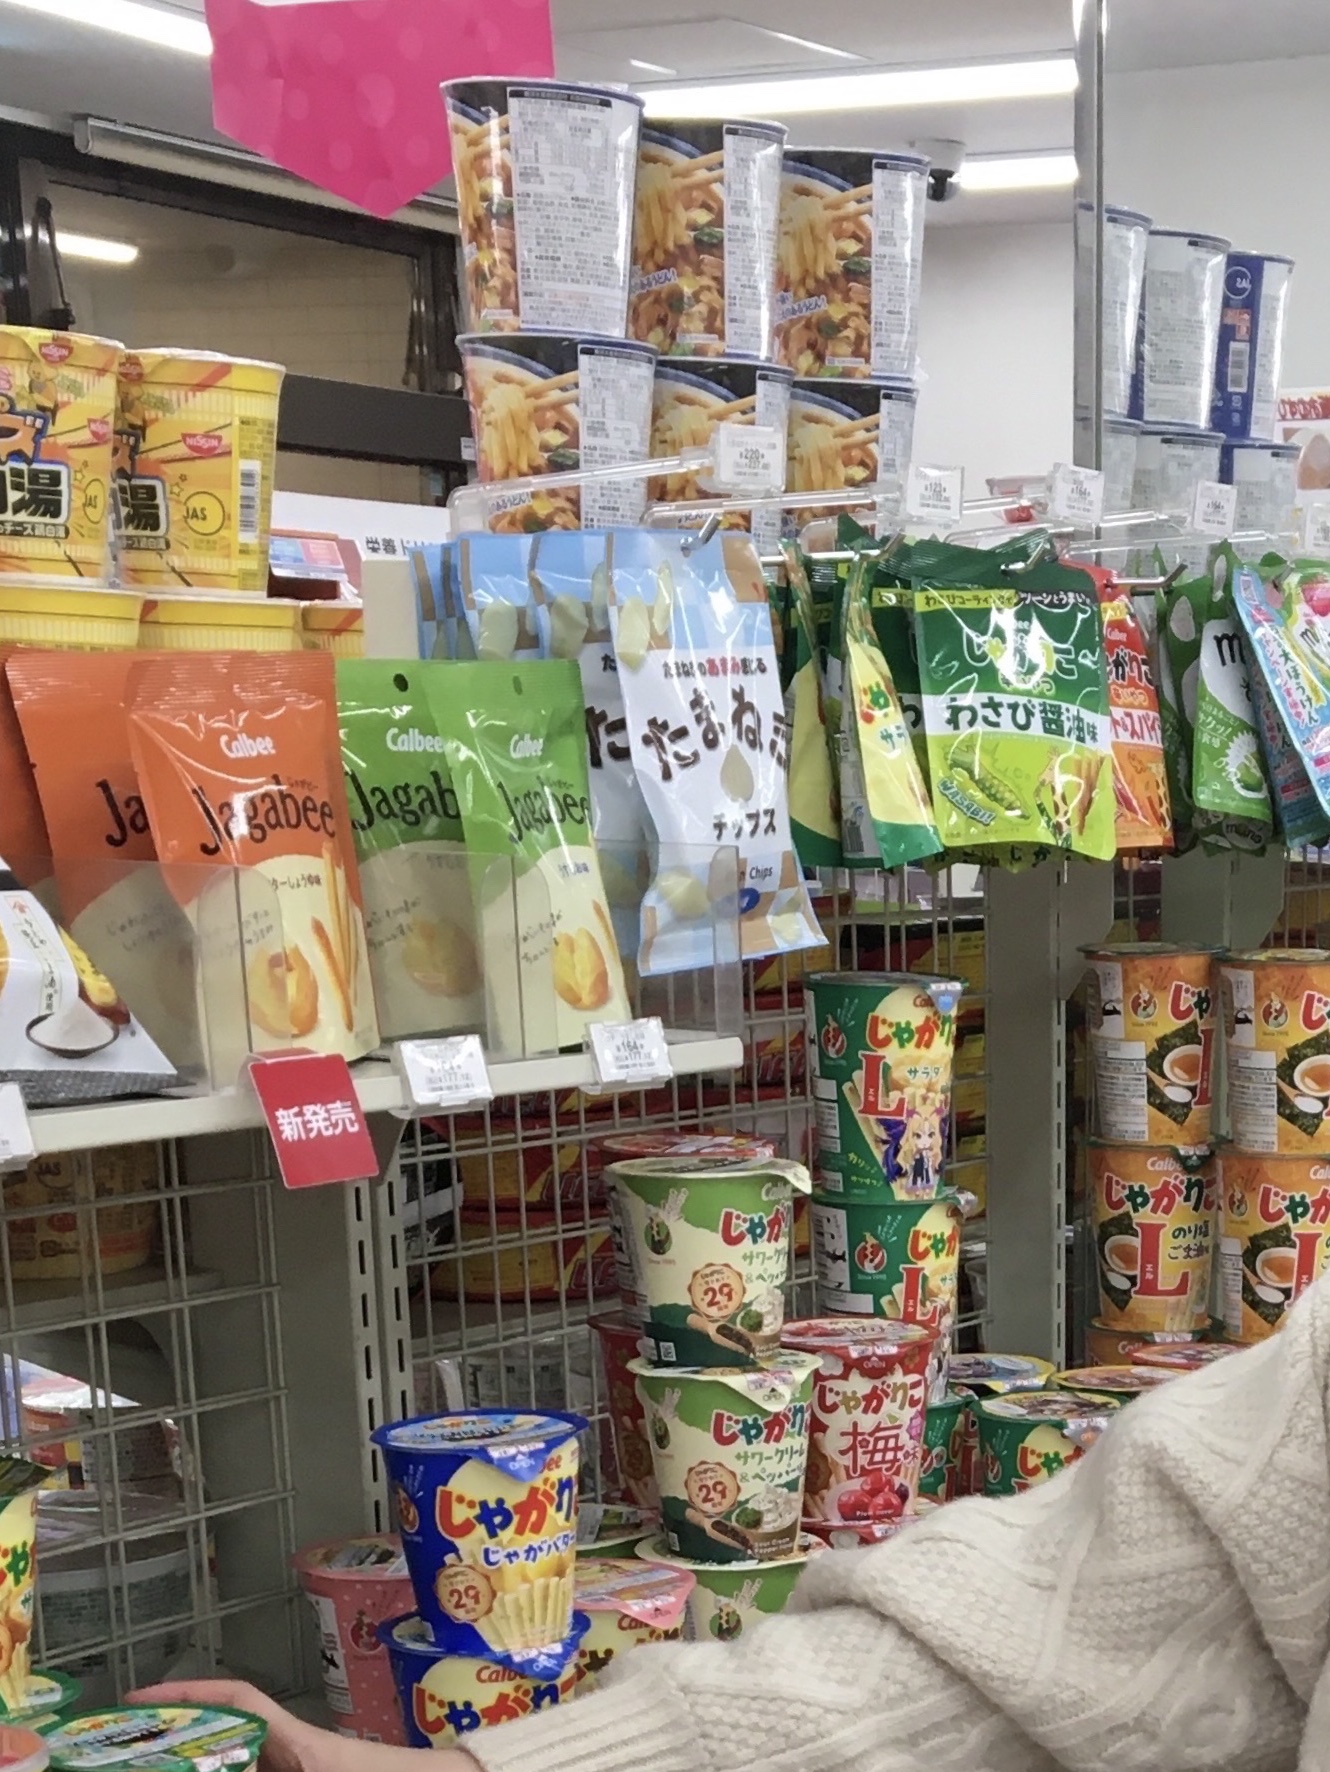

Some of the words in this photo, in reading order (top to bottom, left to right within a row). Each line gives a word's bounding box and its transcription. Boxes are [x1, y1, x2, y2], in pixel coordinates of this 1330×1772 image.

[185, 435, 221, 448] NISSIN
[183, 506, 208, 521] JAS
[945, 695, 1100, 745] わさび醤油味
[219, 733, 276, 759] Calbee
[386, 726, 445, 754] Calbee
[196, 773, 337, 856] Jagabee
[713, 811, 777, 838] チップス
[749, 865, 774, 881] Chips
[274, 1099, 360, 1143] 新発売
[1131, 1220, 1191, 1298] L
[702, 1283, 734, 1308] 29
[816, 1378, 923, 1418] じゃがりこ
[698, 1480, 728, 1505] 29
[447, 1583, 481, 1611] 29
